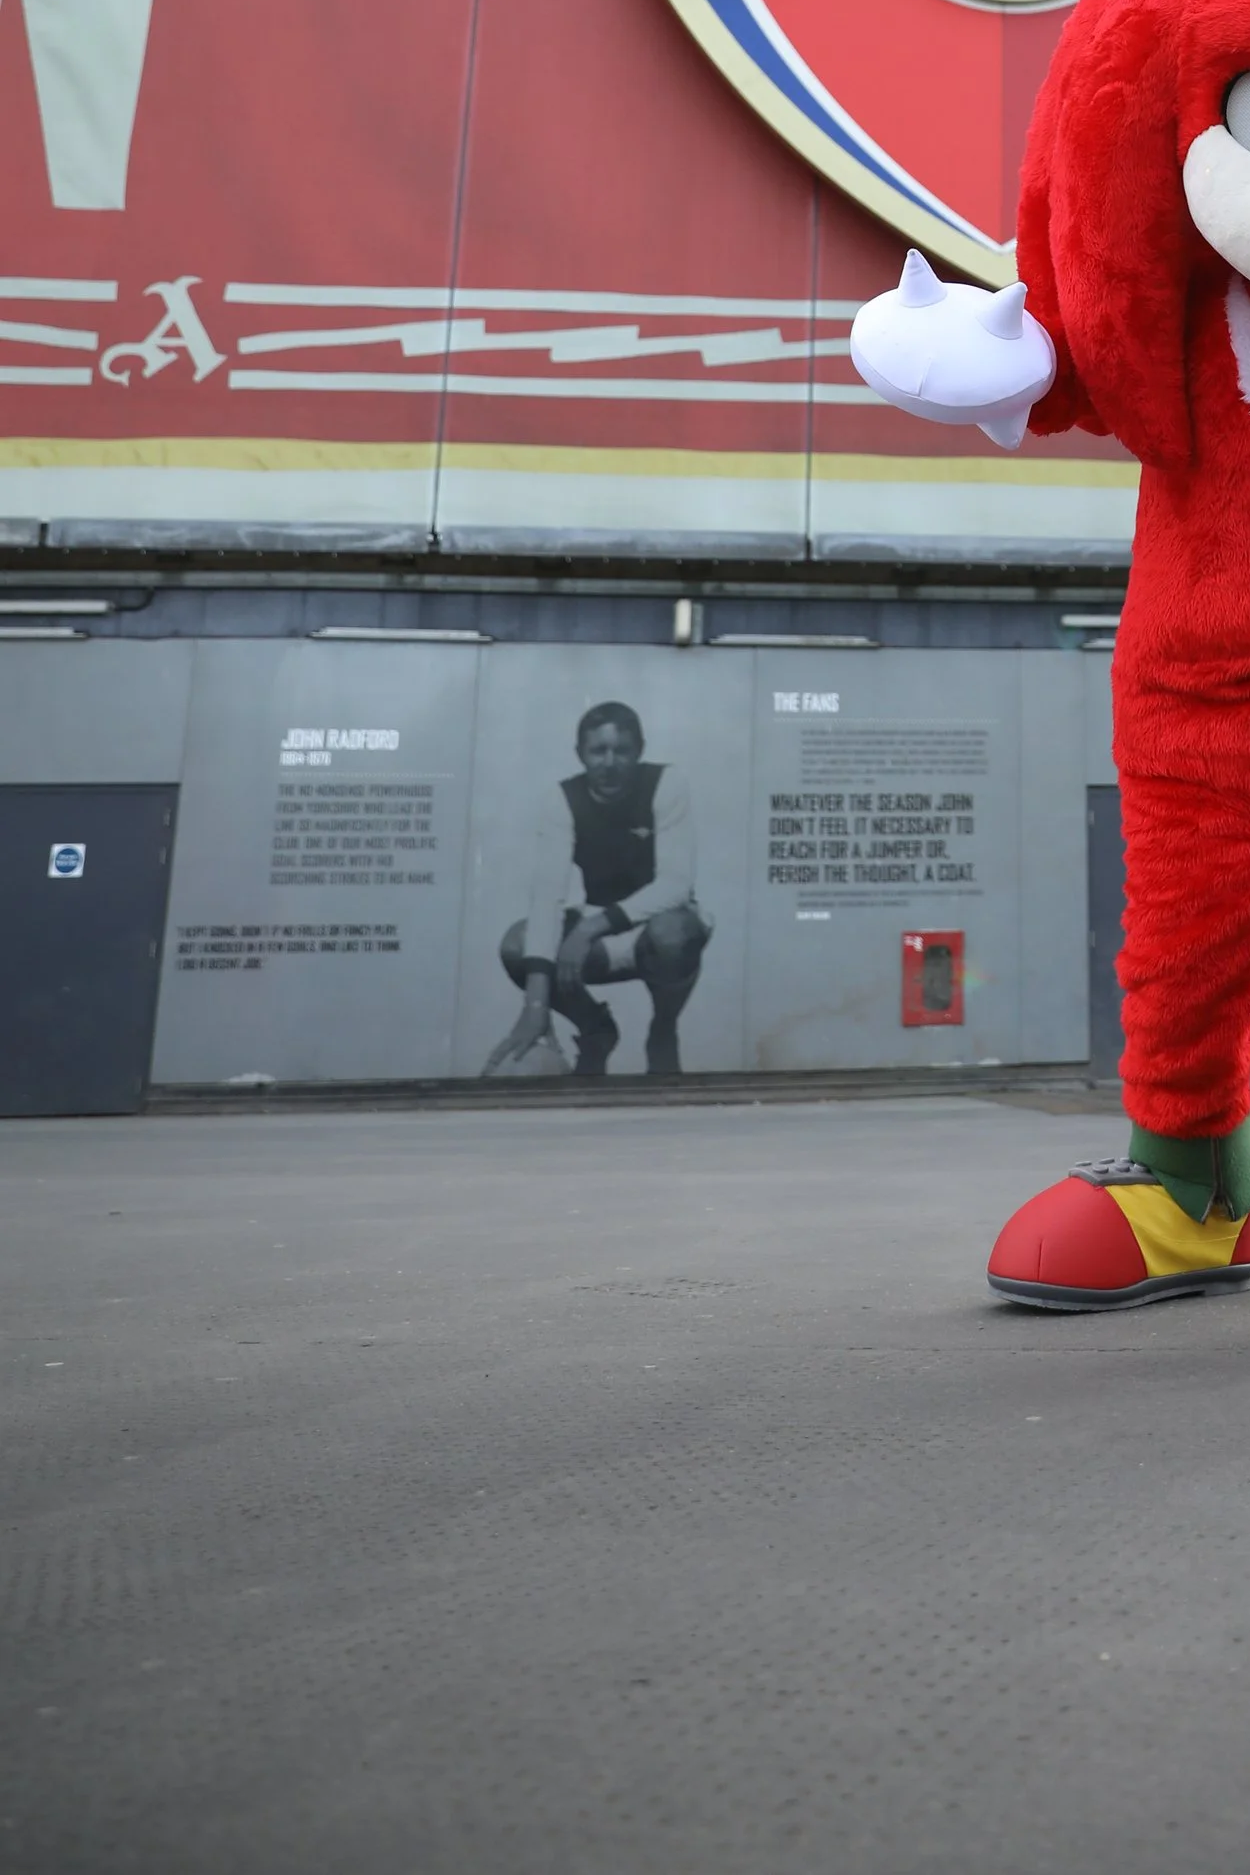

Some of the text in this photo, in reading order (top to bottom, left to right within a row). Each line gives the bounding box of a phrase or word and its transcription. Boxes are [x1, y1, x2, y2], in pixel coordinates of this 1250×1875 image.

[772, 692, 840, 713] THE FANS
[280, 728, 400, 751] JOHN RADFORD
[769, 793, 975, 813] WHATEVER THE SEASON JOHN
[818, 816, 851, 837] FEEL
[854, 816, 868, 837] IT
[870, 816, 952, 837] NECESSARY
[955, 816, 975, 837] TO
[768, 839, 951, 860] REACH FOR A JUMPER OR,
[767, 863, 820, 884] PERISH
[823, 863, 850, 884] THE
[922, 863, 936, 884] A
